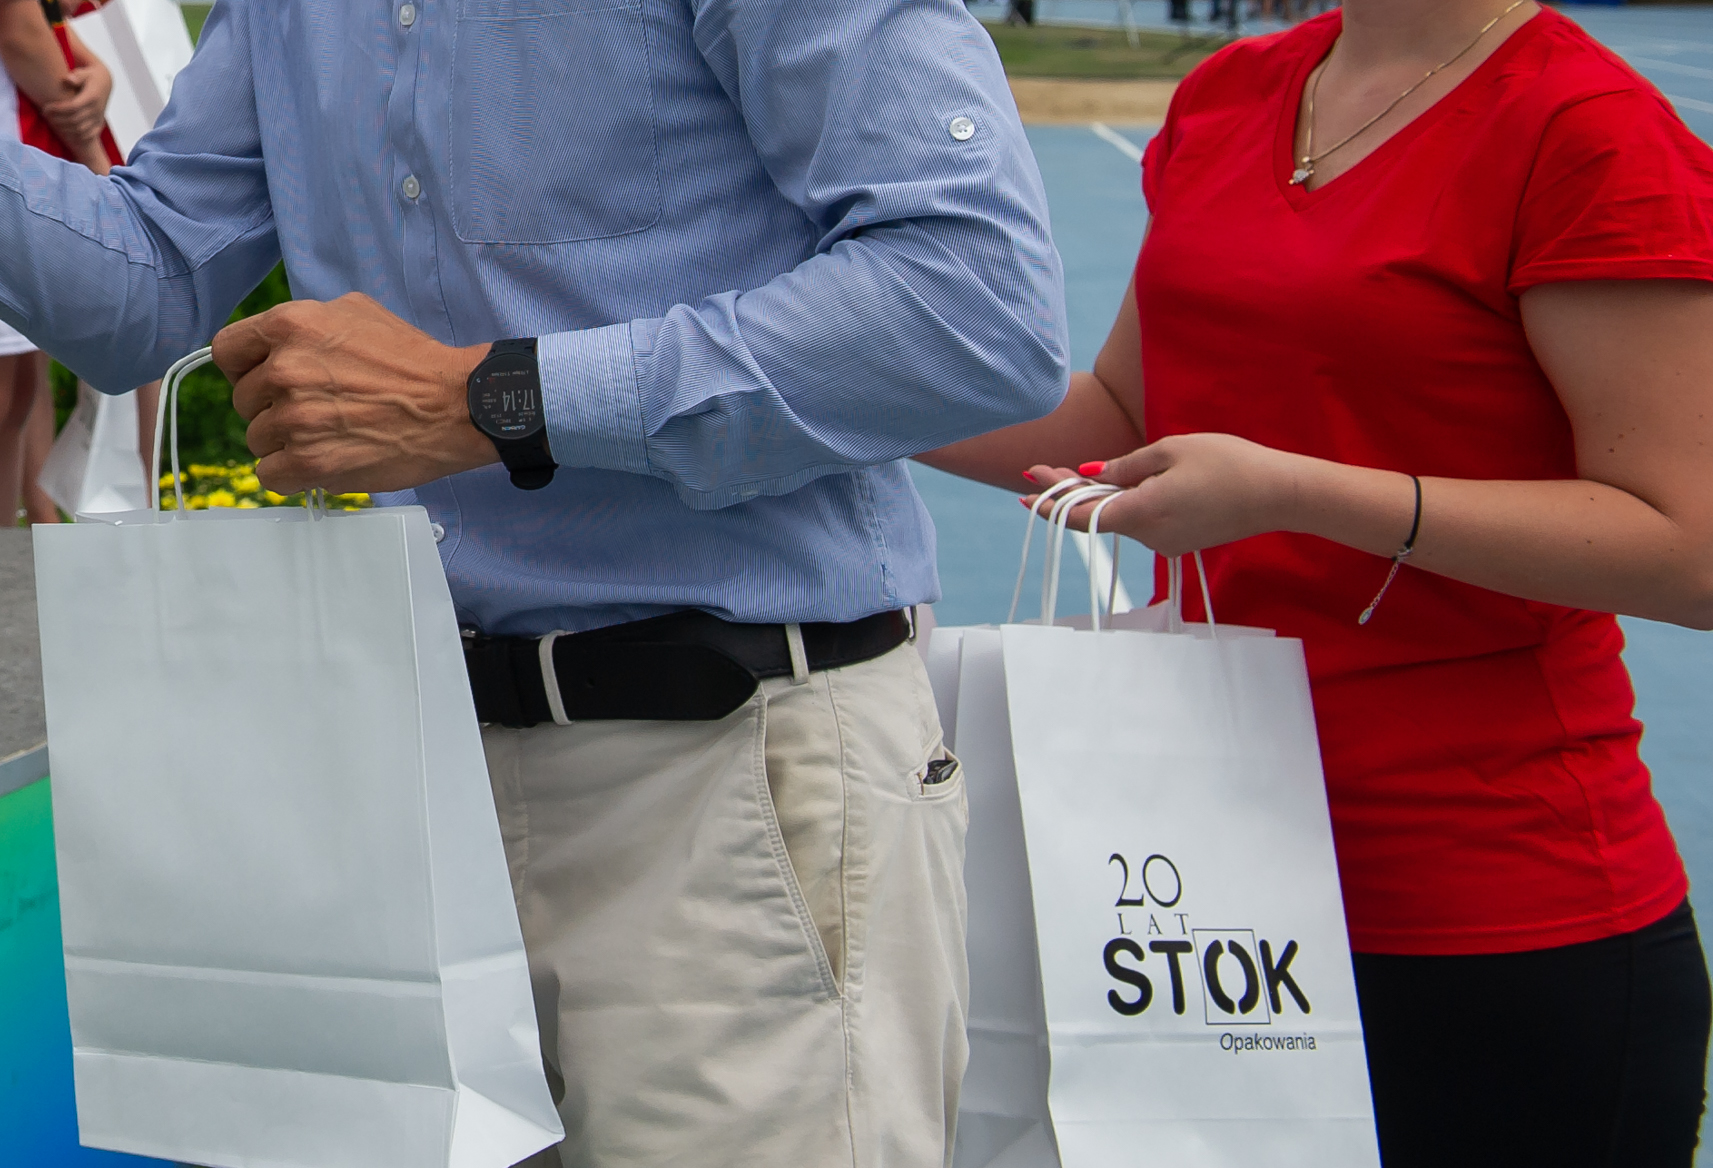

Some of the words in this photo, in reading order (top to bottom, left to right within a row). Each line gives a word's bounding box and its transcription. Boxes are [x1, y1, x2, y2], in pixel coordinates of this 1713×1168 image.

[501, 389, 536, 412] 17:14
[1108, 853, 1183, 908] 20
[1117, 913, 1190, 935] LAT
[1103, 937, 1312, 1016] STOK
[1219, 1032, 1317, 1054] Opakowania
